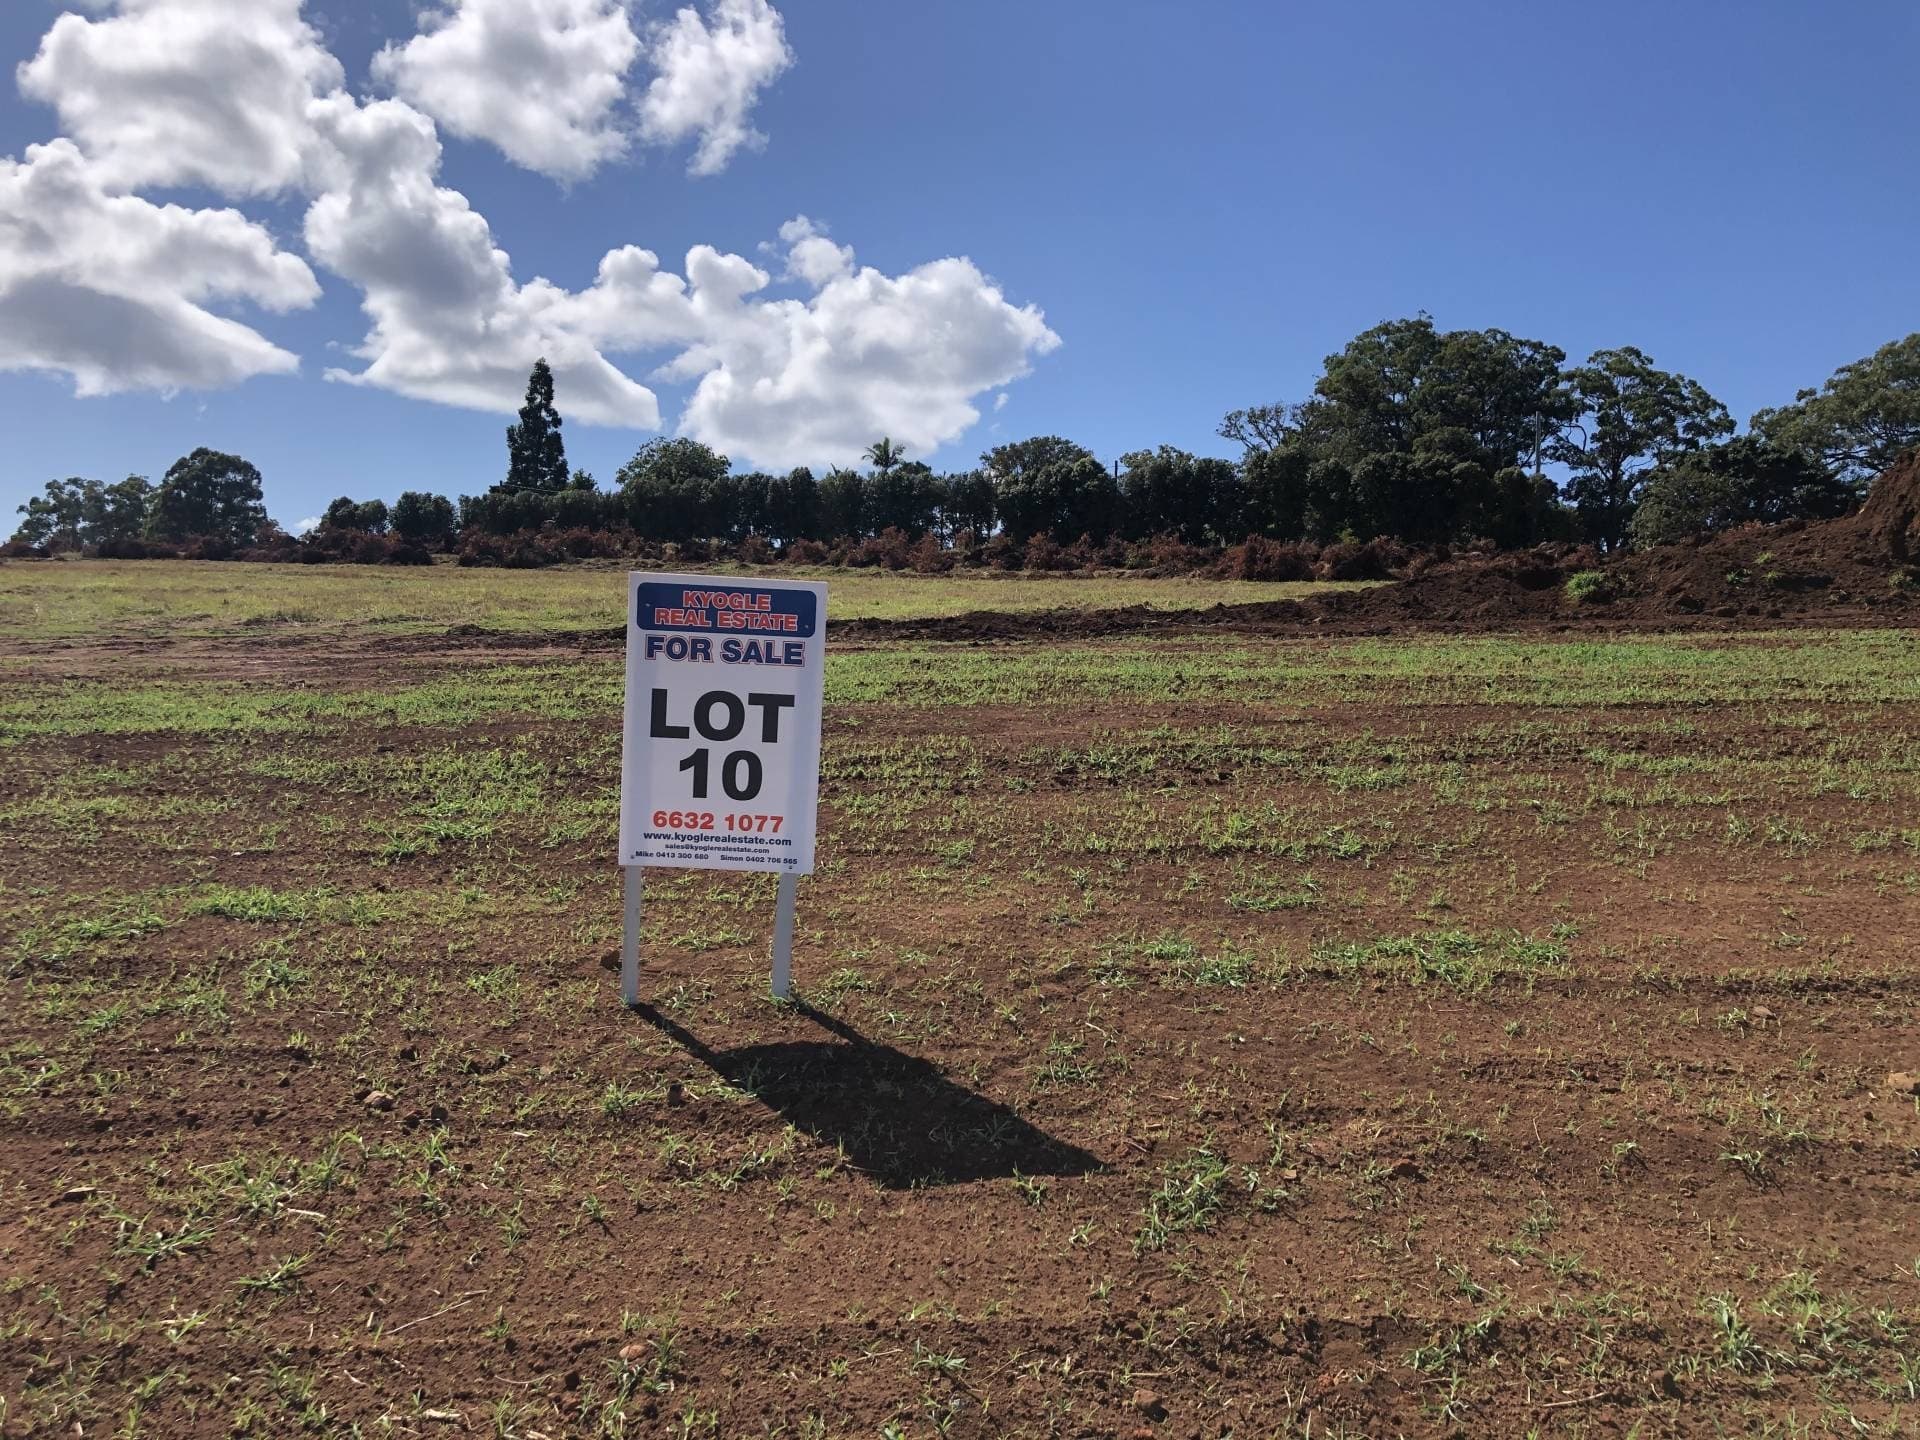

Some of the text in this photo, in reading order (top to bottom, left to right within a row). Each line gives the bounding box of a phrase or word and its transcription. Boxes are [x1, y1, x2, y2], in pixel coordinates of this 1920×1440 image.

[683, 591, 771, 611] KYOGLE
[655, 608, 798, 631] REAL ESTATE
[645, 634, 805, 667] FOR SALE
[650, 688, 795, 743] LOT
[679, 748, 763, 801] 10
[653, 811, 784, 833] 6632 1077
[643, 831, 792, 846] www.kyoglerealestate.com
